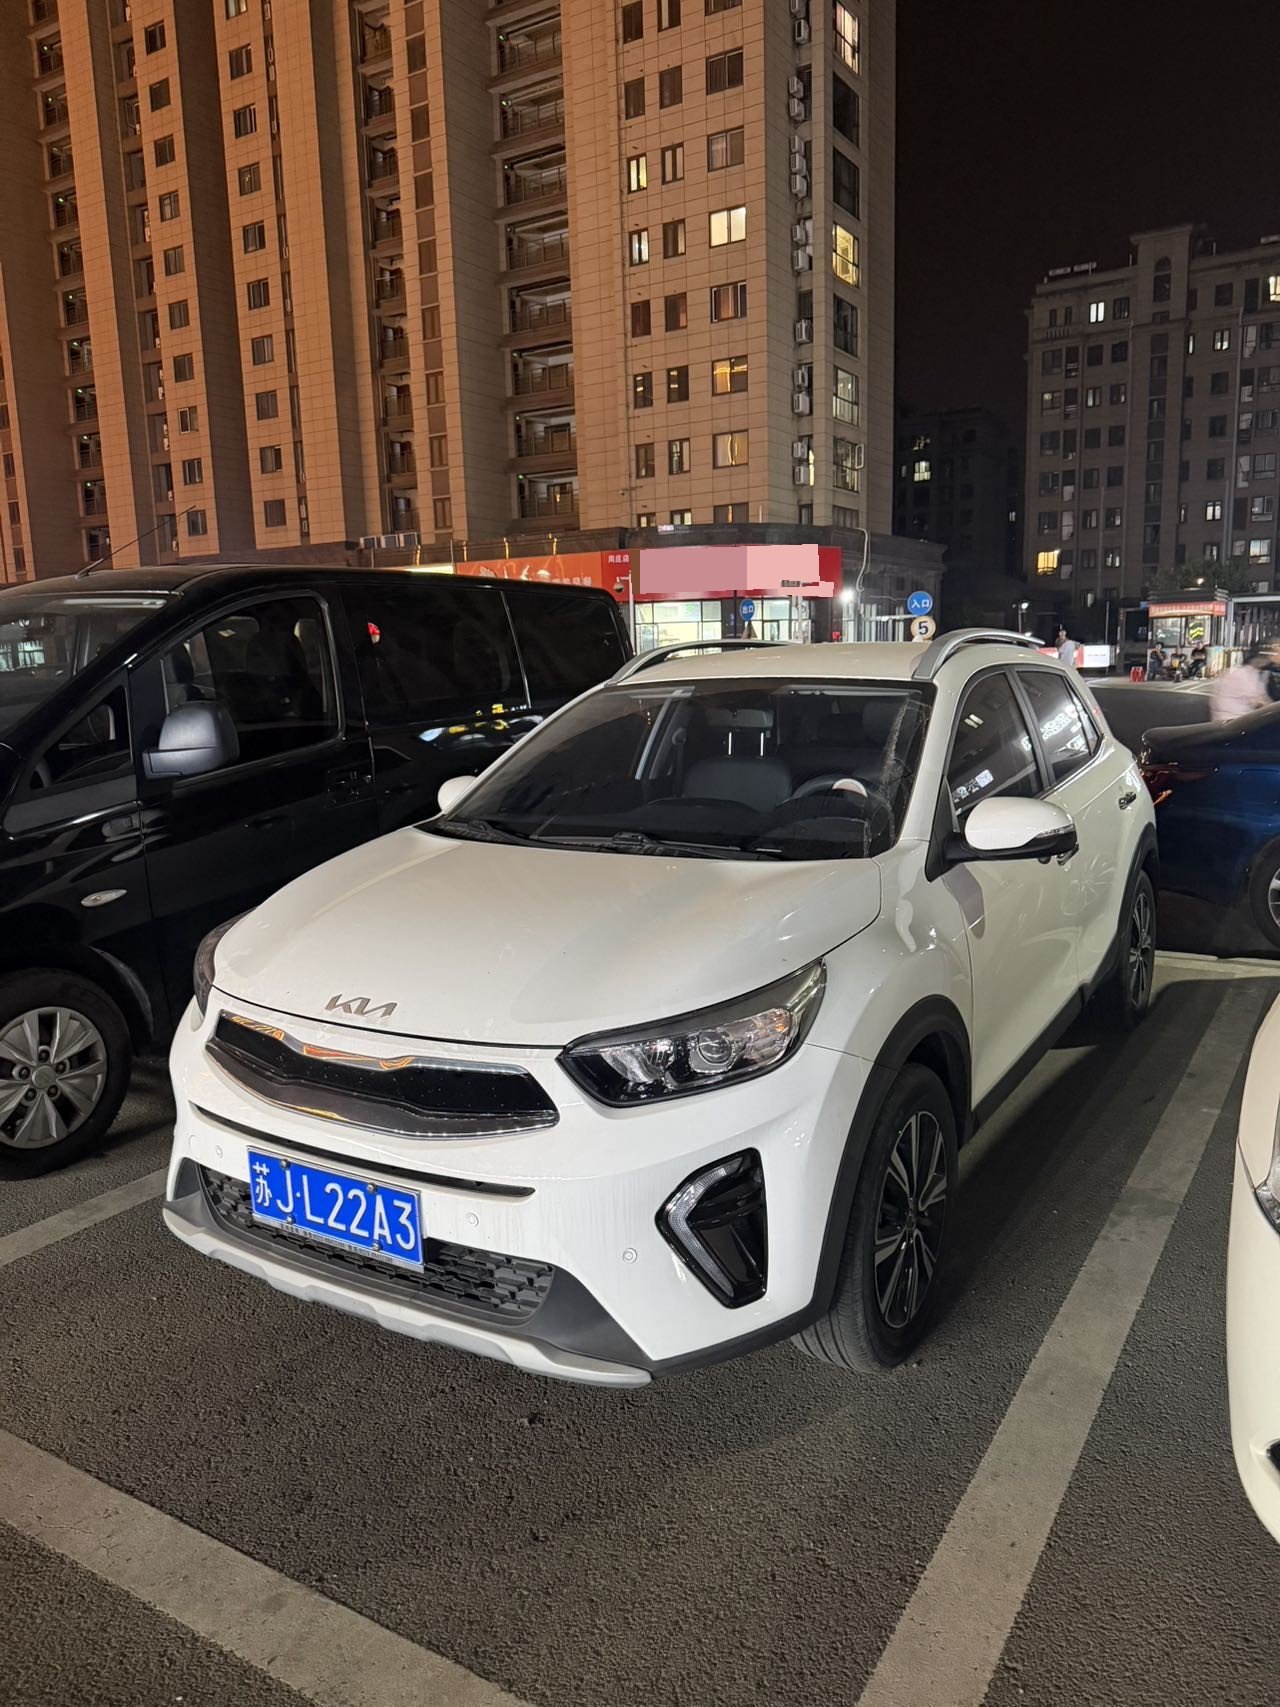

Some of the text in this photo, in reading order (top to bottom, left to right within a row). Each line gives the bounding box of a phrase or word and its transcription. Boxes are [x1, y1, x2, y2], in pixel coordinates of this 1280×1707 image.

[911, 599, 930, 608] 入口
[742, 605, 754, 614] 出口
[918, 620, 929, 635] 5
